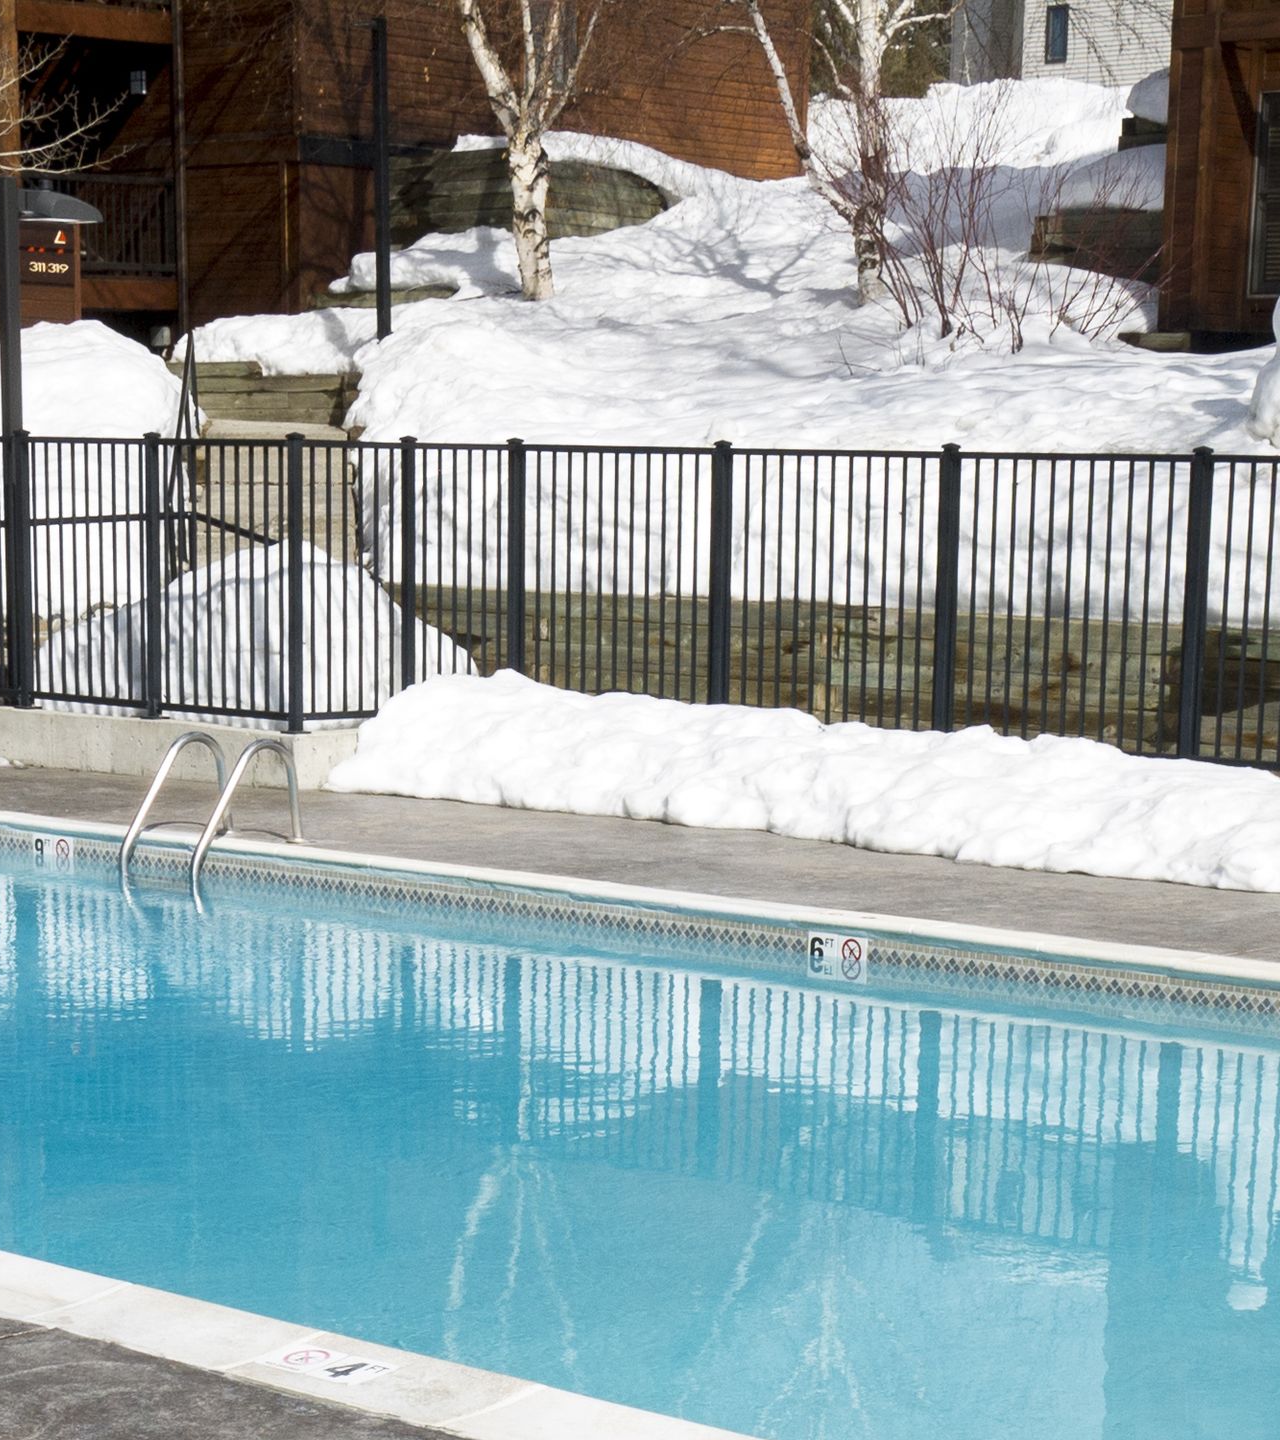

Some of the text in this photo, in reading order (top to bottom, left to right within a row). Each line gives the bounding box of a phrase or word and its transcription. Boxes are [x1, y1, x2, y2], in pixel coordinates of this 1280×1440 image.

[29, 261, 69, 274] 311 319
[810, 937, 834, 957] 6 FT
[323, 1362, 370, 1379] 4
